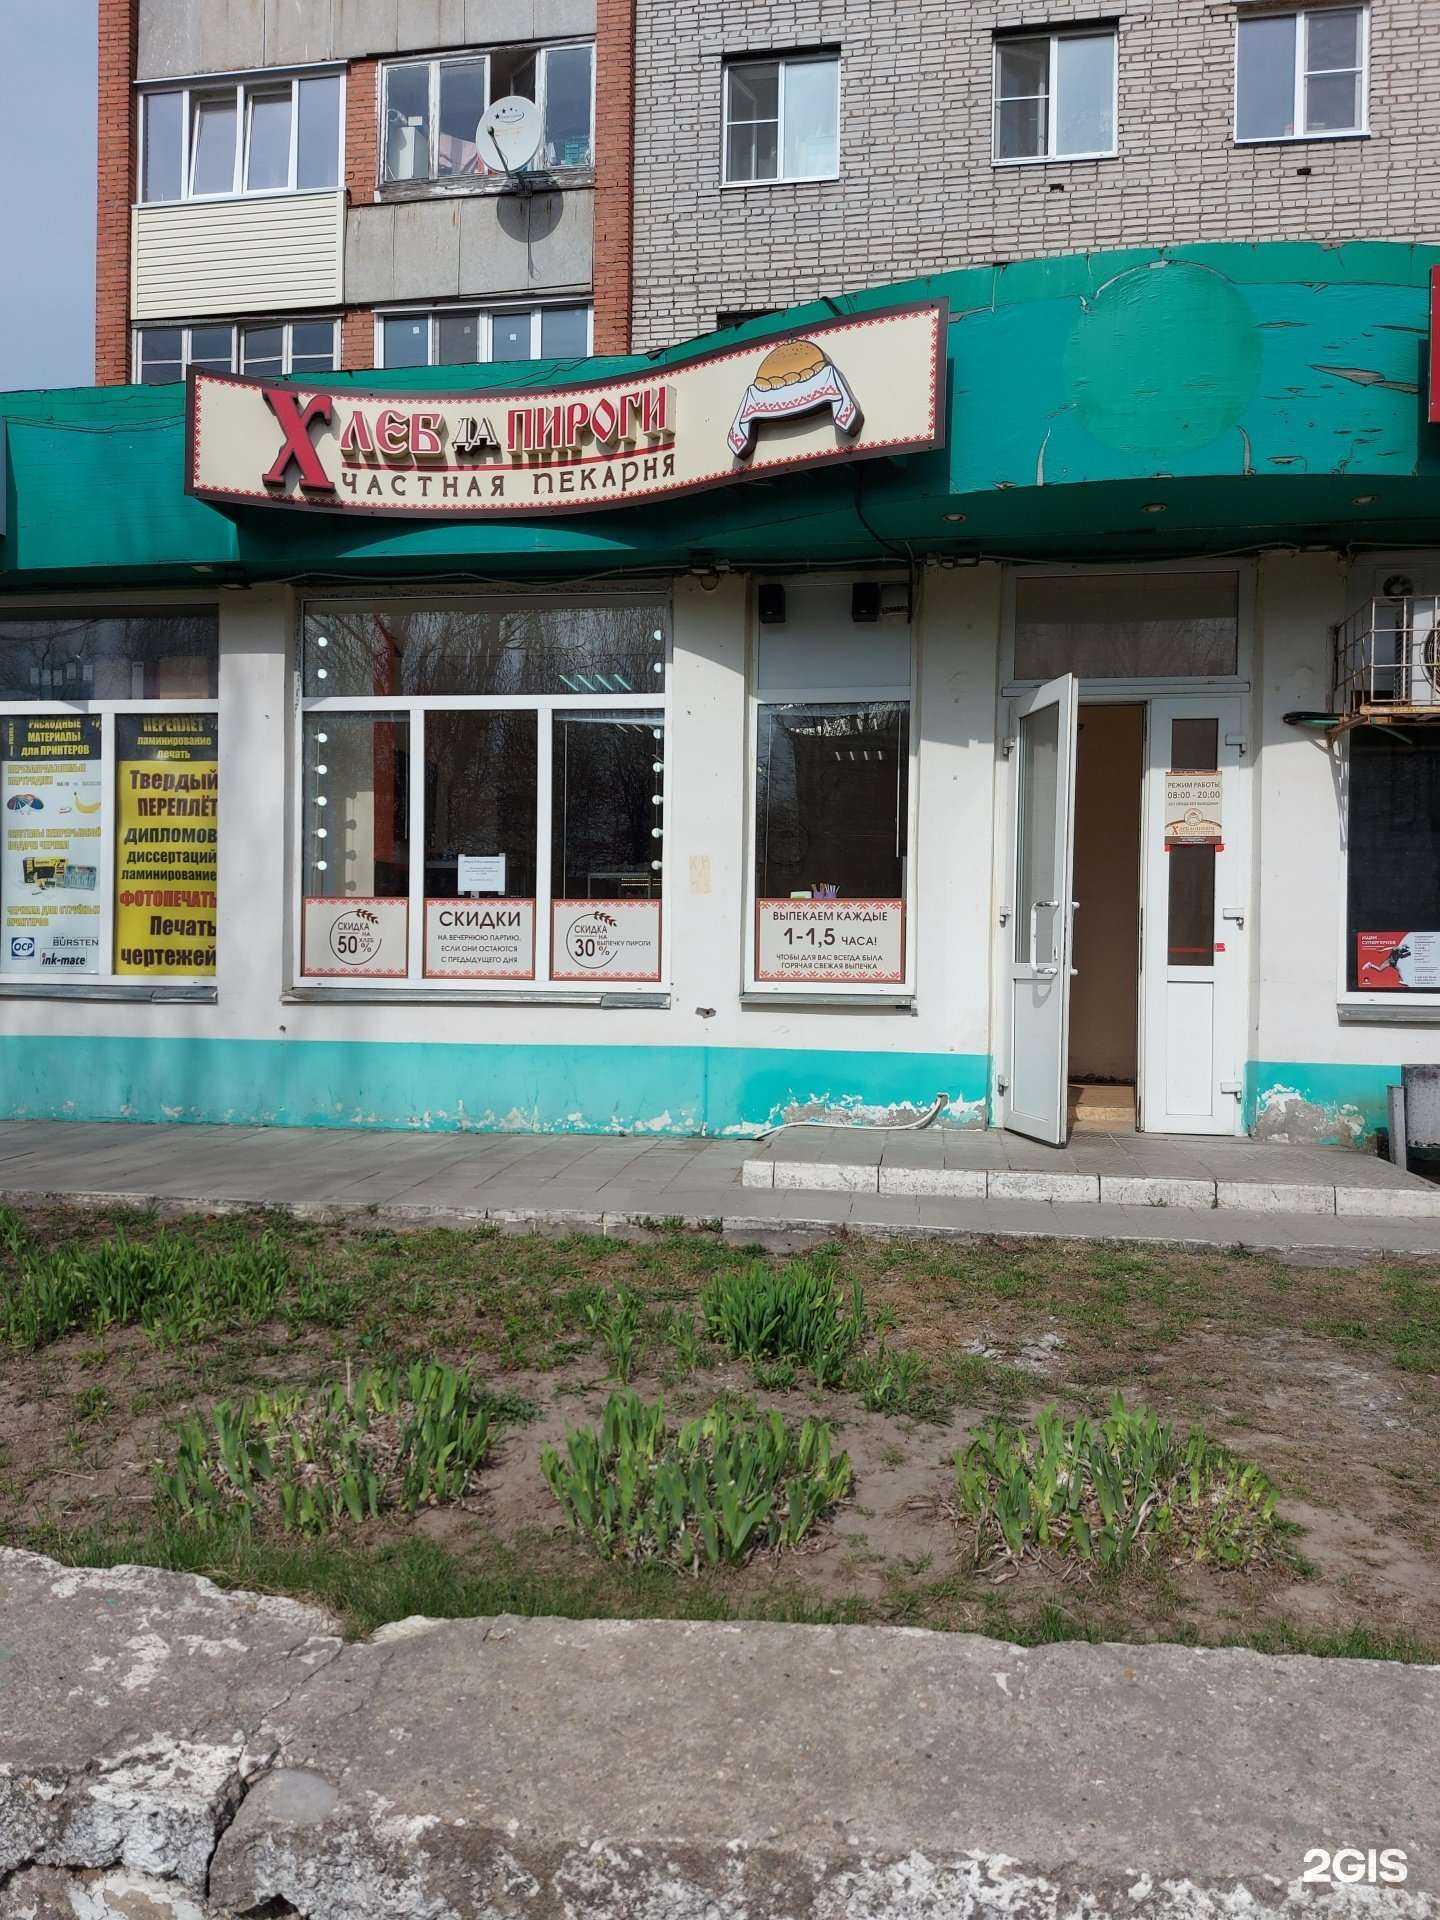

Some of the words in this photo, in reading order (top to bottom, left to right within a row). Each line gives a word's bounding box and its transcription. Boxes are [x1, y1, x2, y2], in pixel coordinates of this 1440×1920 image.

[262, 388, 443, 494] ХЛЕБ
[451, 415, 500, 451] ДА
[506, 386, 673, 454] ПИРОГИ
[341, 471, 505, 498] ЧАСТНАЯ
[532, 453, 676, 495] ПЕКАРНЯ
[27, 732, 81, 743] МАТЕРИАЛЫ
[40, 745, 90, 756] ПРИНТЕРОВ
[129, 769, 217, 792] Твердый
[1167, 791, 1191, 800] 08:00
[1197, 791, 1221, 799] 20:00
[126, 850, 217, 865] диссертаций
[121, 869, 217, 881] ламинирование
[439, 911, 521, 930] СКИДКИ
[773, 911, 834, 921] ВЫПЕКАЕМ
[836, 911, 888, 922] КАЖДЫЕ
[150, 916, 217, 936] Печать
[337, 921, 370, 931] СКИДКА
[574, 924, 608, 935] СКИДКА
[783, 927, 836, 948] 1-1,5
[841, 936, 878, 946] ЧАСА!
[120, 947, 217, 968] чертежей
[448, 956, 501, 964] ПРЕДЫДУЩЕГО
[776, 953, 800, 961] ЧТОБЫ
[833, 954, 860, 962] ВСЕГДА
[781, 962, 812, 970] ГОРЯЧАЯ
[813, 962, 844, 970] СВЕЖАЯ
[845, 962, 877, 970] ВЫПЕЧКА
